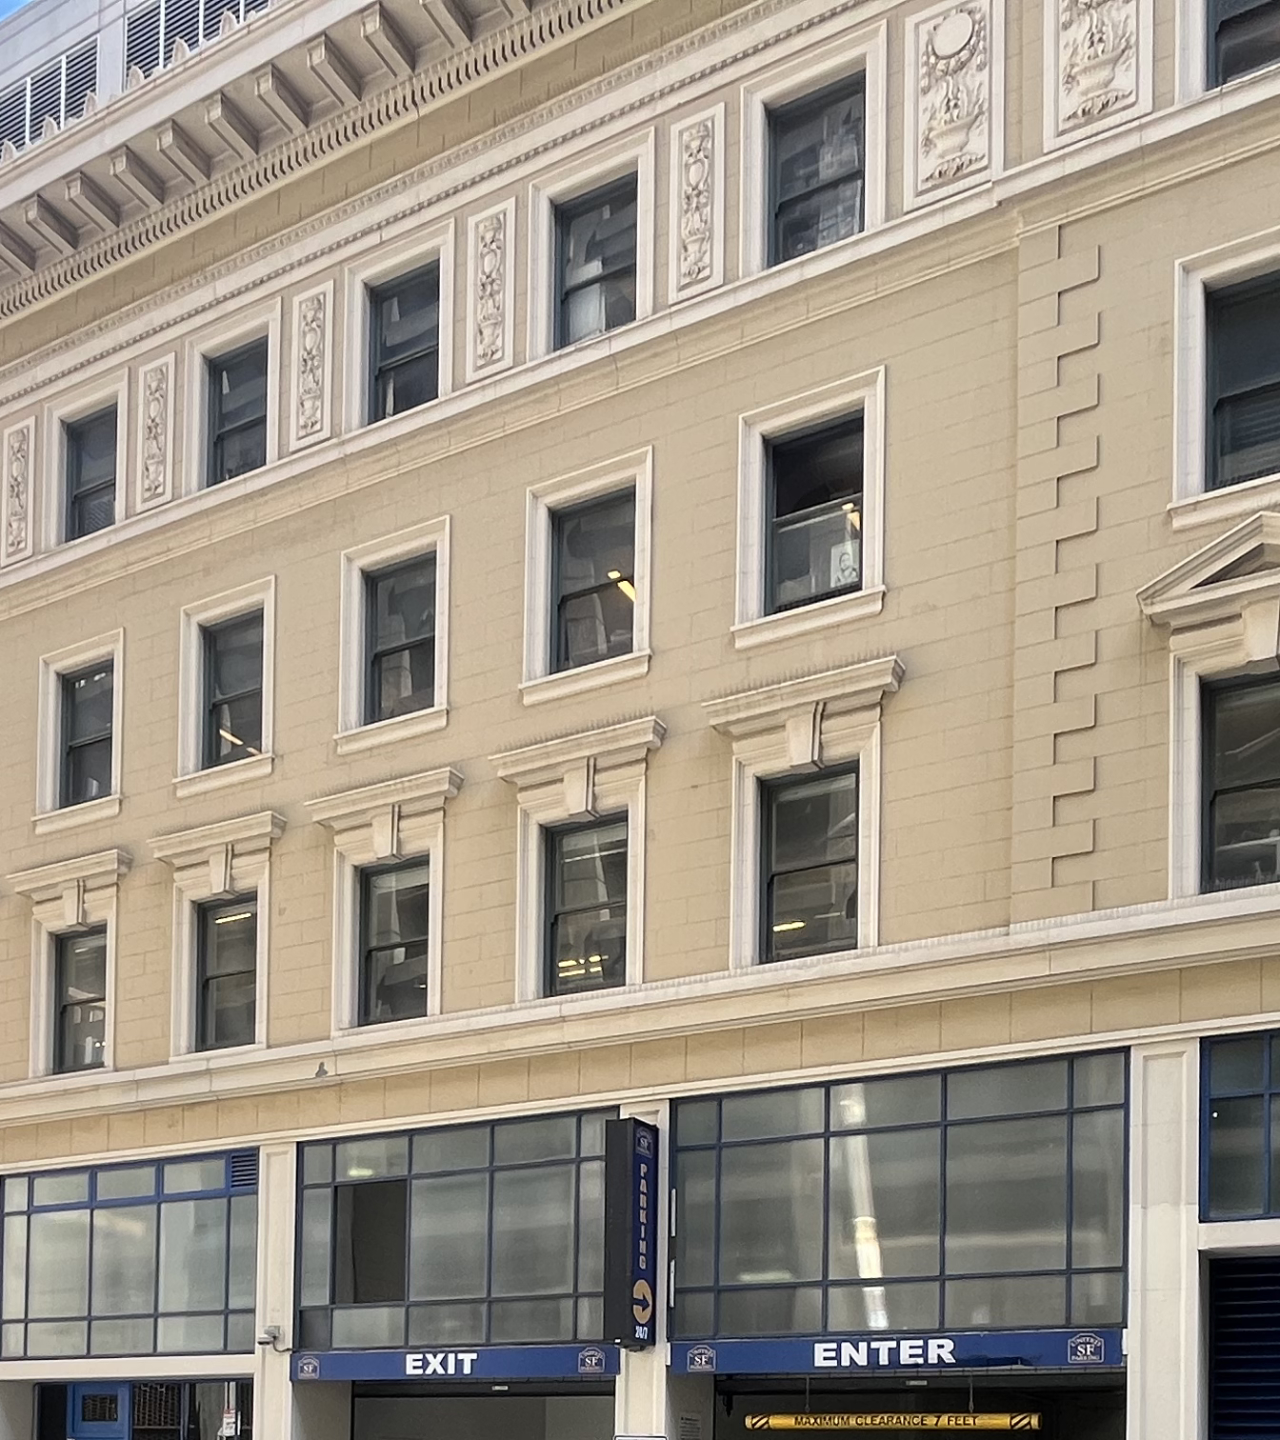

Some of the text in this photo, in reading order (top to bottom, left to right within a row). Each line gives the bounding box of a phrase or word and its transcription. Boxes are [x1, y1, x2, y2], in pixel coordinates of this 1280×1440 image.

[639, 1163, 648, 1270] PARKING
[635, 1325, 648, 1339] 24/7
[813, 1338, 957, 1367] ENTER
[1077, 1344, 1095, 1356] SF
[405, 1353, 477, 1375] EXIT
[694, 1355, 708, 1366] SF
[794, 1415, 979, 1427] MAXIMUM CLEARANCE 7 FEET
